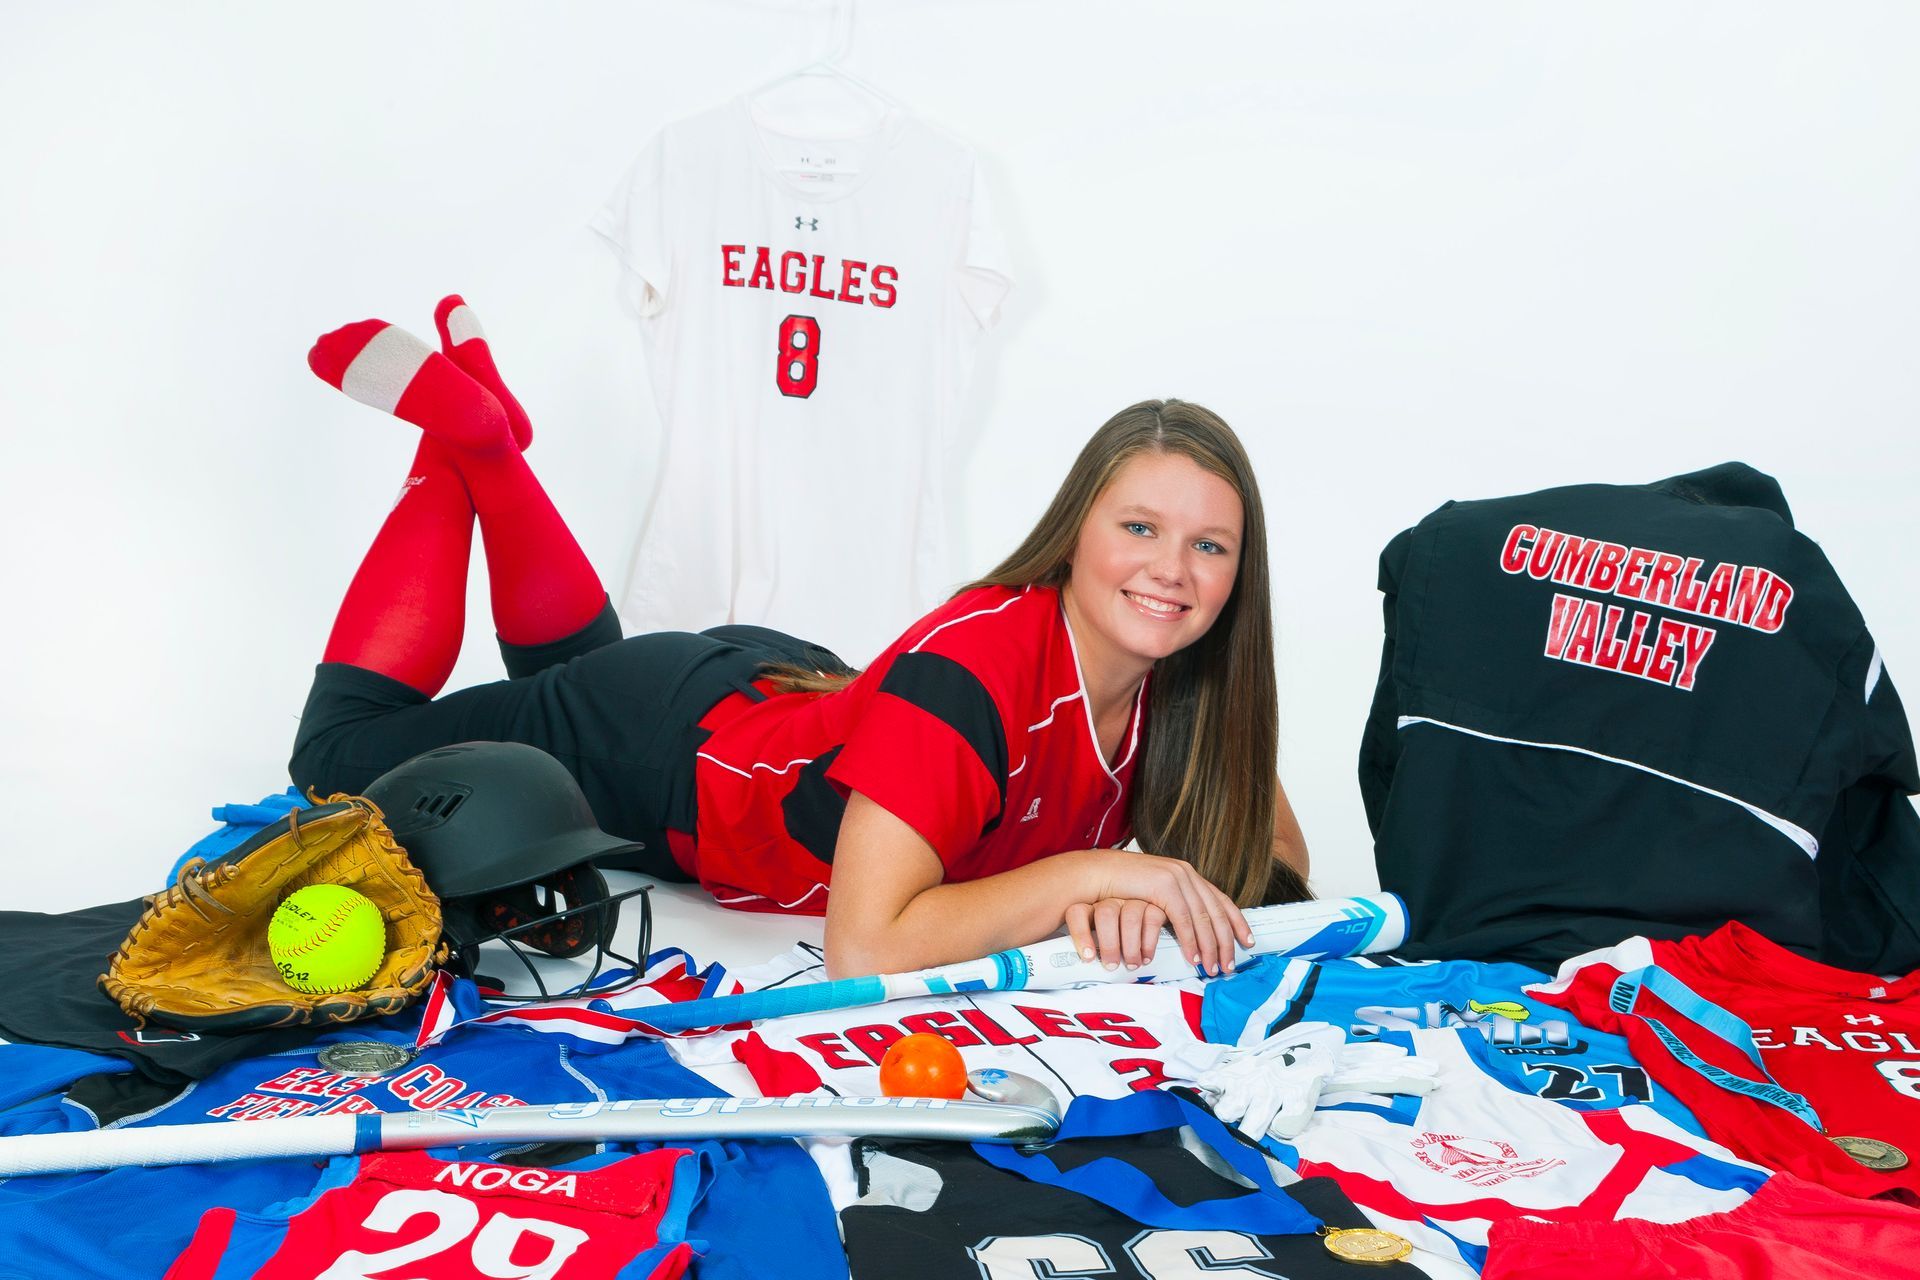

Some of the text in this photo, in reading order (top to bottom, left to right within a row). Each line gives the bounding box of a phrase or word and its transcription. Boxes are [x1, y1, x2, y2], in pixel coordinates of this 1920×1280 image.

[721, 245, 898, 309] EAGLES
[776, 314, 821, 399] 8
[1500, 524, 1794, 634] CUMBERLAND
[1543, 593, 1717, 692] VALLEY
[1336, 922, 1368, 935] -10
[1612, 981, 1636, 1013] MID
[255, 1067, 390, 1097] EAS
[1522, 1062, 1654, 1102] 27
[433, 1163, 577, 1198] NOGA
